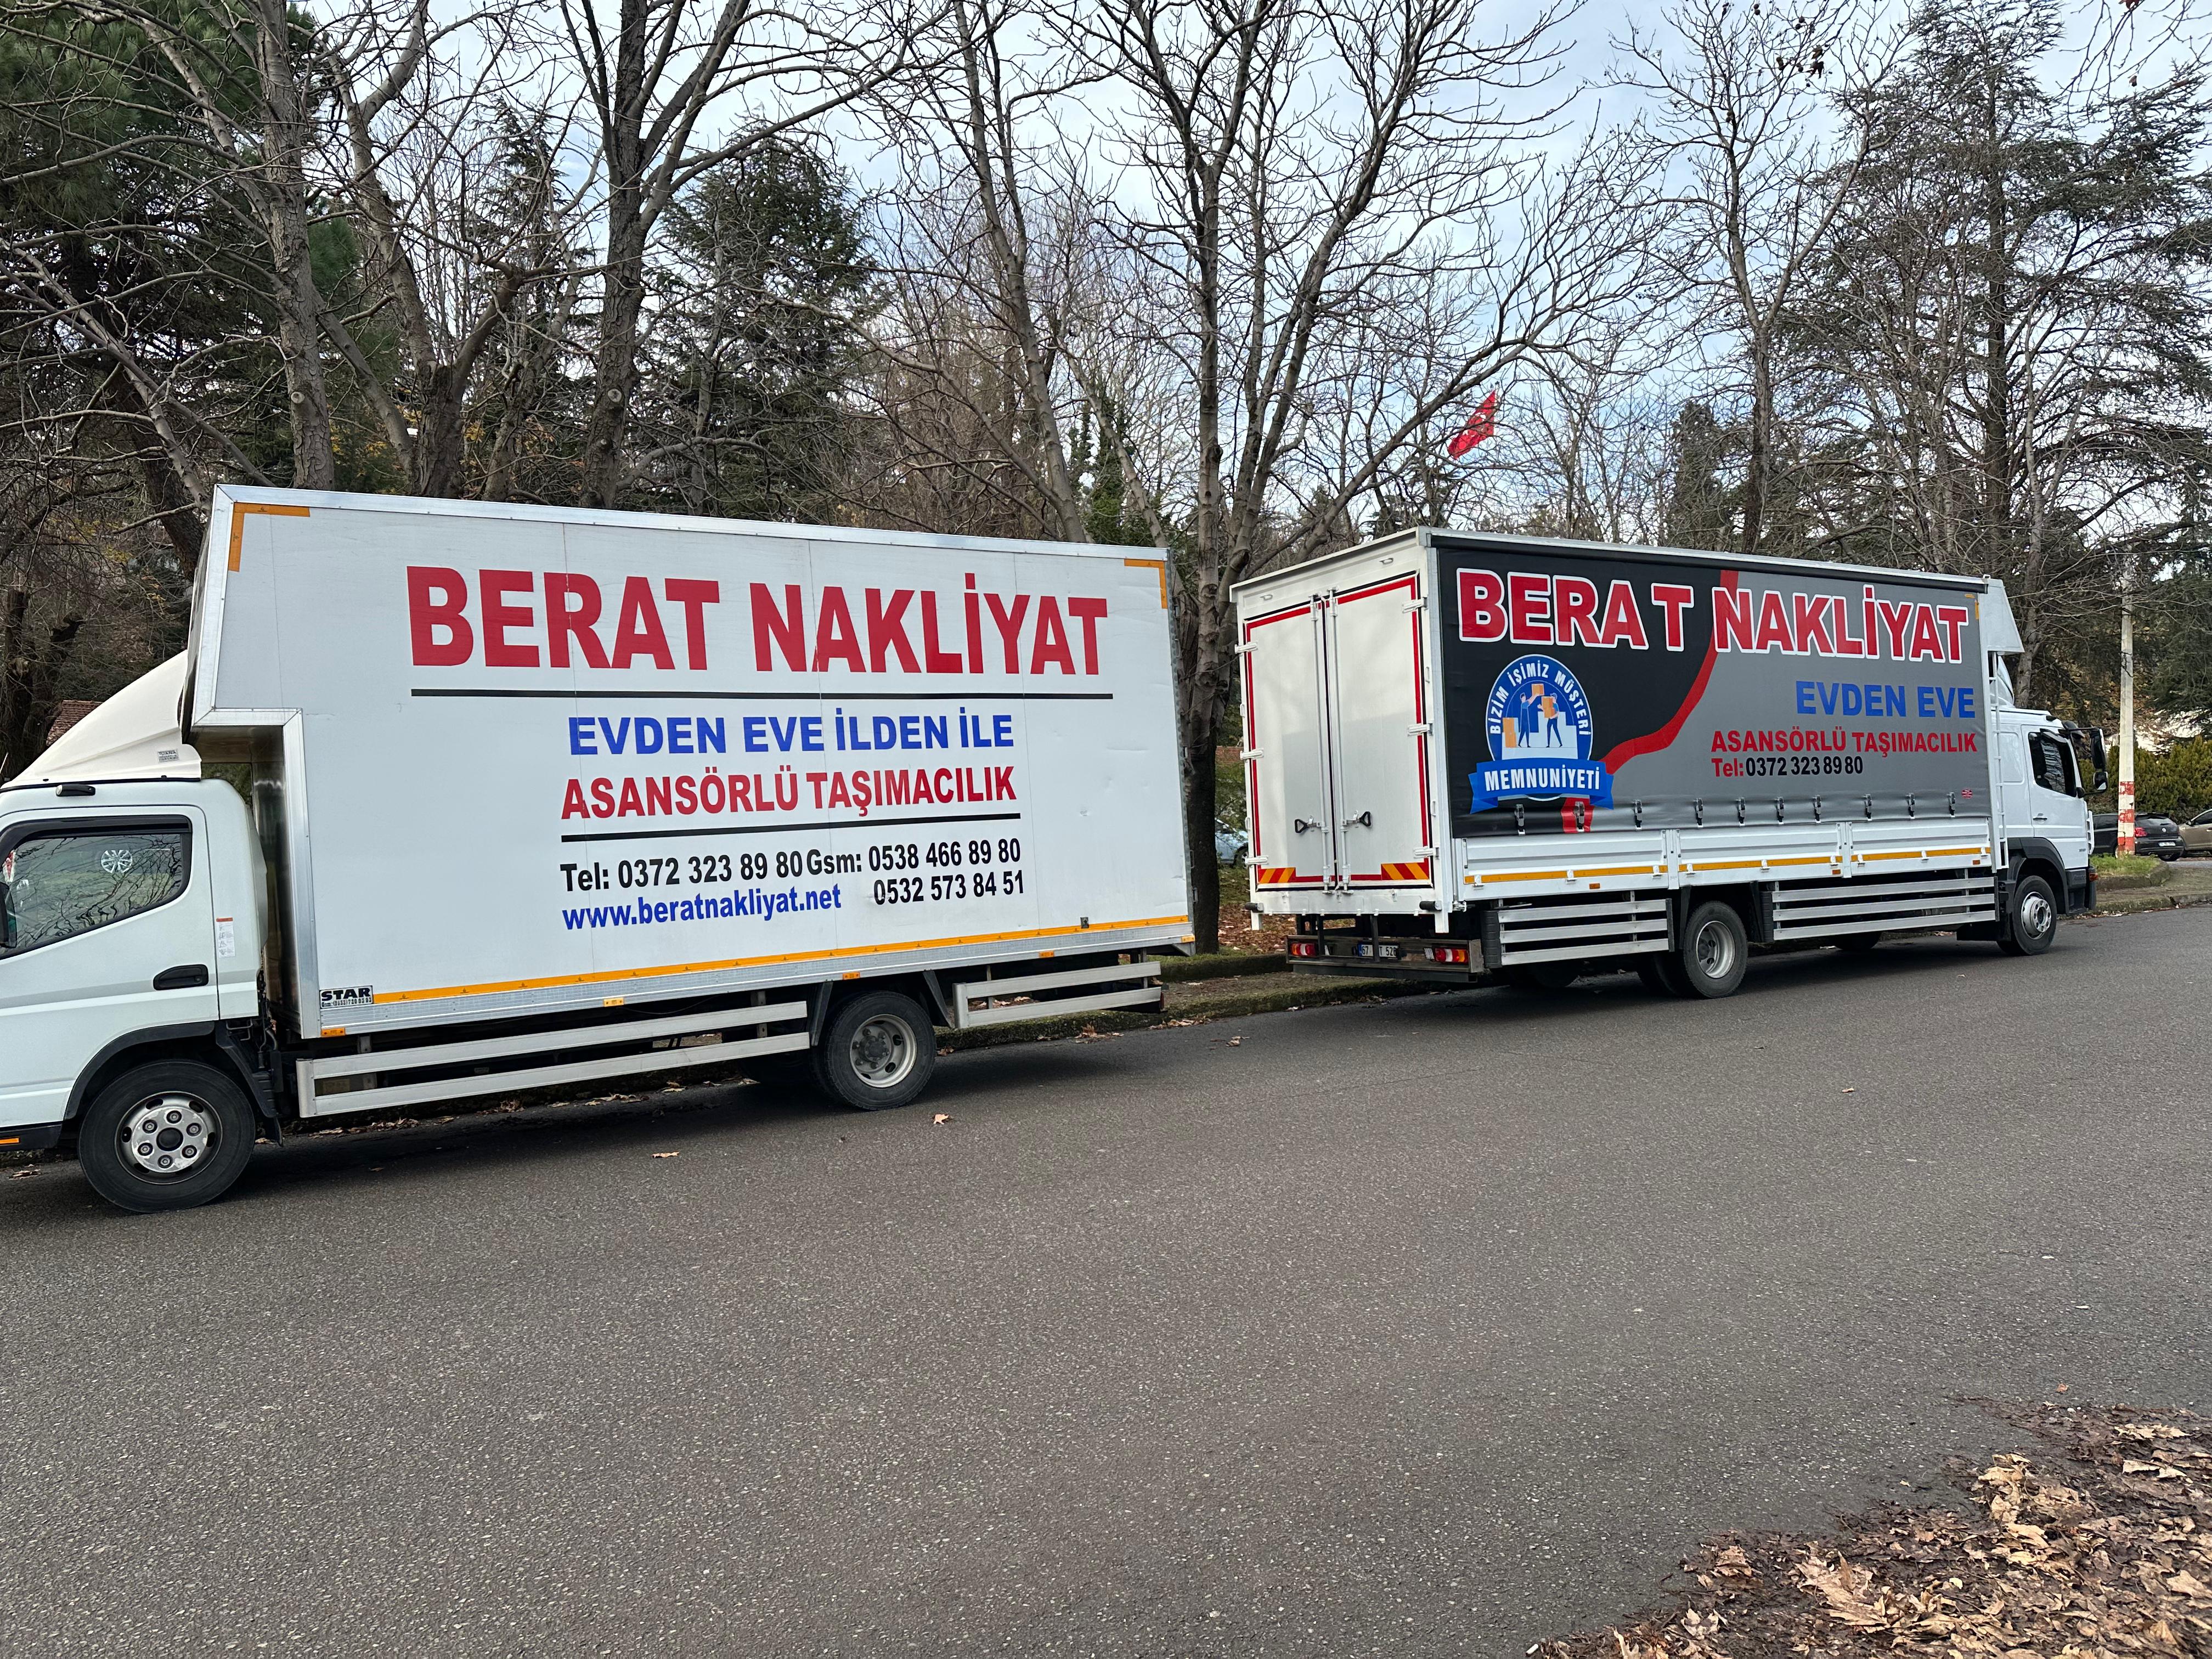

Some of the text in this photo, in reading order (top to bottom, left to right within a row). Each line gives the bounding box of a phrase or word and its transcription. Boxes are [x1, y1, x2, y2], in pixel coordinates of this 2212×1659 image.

[407, 566, 1108, 675] BERAT NAKLİYAT
[1457, 568, 1968, 663] BERAT NAKLİYAT
[1488, 660, 1591, 735] BİZİM İŞİMİZ MÜŞTERİ
[1796, 681, 1975, 718] EVDEN EVE
[568, 707, 1014, 755] EVDEN EVE İLDEN İLE
[1711, 726, 1977, 757] ASANSÖRLÜ TAŞIMACILIK
[1485, 765, 1600, 791] MEMNUNİYETİ
[1711, 758, 1743, 777] Tel:
[1746, 757, 1787, 776] 0372
[1791, 757, 1820, 775] 323
[561, 765, 1017, 819] ASANSÖRLÜ TAŞIMACILIK
[560, 838, 1020, 891] Tel: 0372 323 89 80 Gsm: 0538 466 89 80
[562, 883, 842, 930] www.beratnakliyat.net
[874, 870, 1024, 905] 0532 573 84 51
[1362, 946, 1368, 955] 67
[321, 988, 371, 1001] STAR
